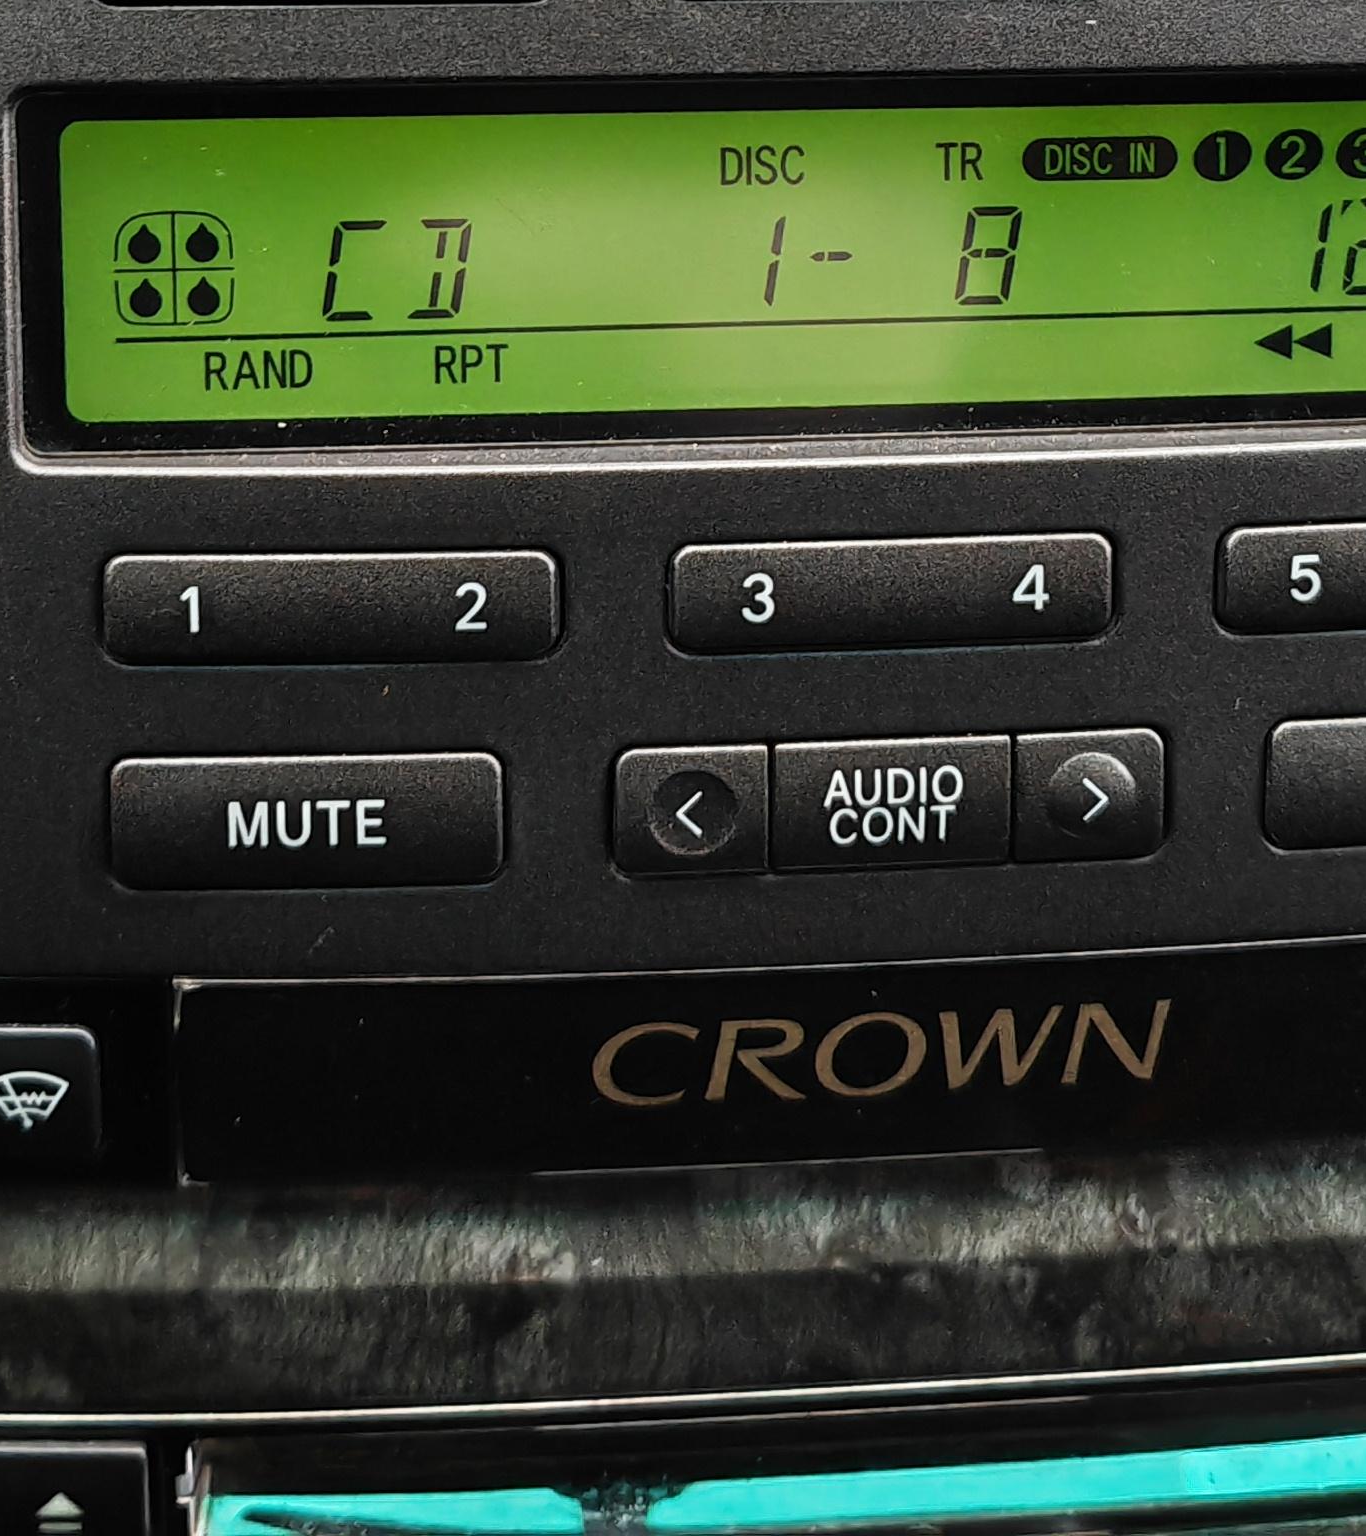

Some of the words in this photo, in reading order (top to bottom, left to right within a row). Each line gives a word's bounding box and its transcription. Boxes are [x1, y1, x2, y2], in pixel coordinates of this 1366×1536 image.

[718, 144, 806, 187] DISC
[935, 141, 985, 183] TR
[1043, 142, 1113, 177] DISC
[1128, 141, 1156, 175] IN
[321, 217, 474, 323] CD
[954, 205, 1024, 306] 8
[203, 348, 315, 392] RAND
[433, 343, 511, 387] RPT
[740, 573, 777, 624] 3
[1011, 563, 1050, 612] 4
[1288, 553, 1324, 603] 5
[177, 585, 203, 634] 1
[453, 582, 489, 632] 2
[823, 764, 965, 810] AUDIO
[226, 798, 389, 849] MUTE
[828, 803, 959, 847] CONT
[591, 997, 1174, 1107] CROWN
